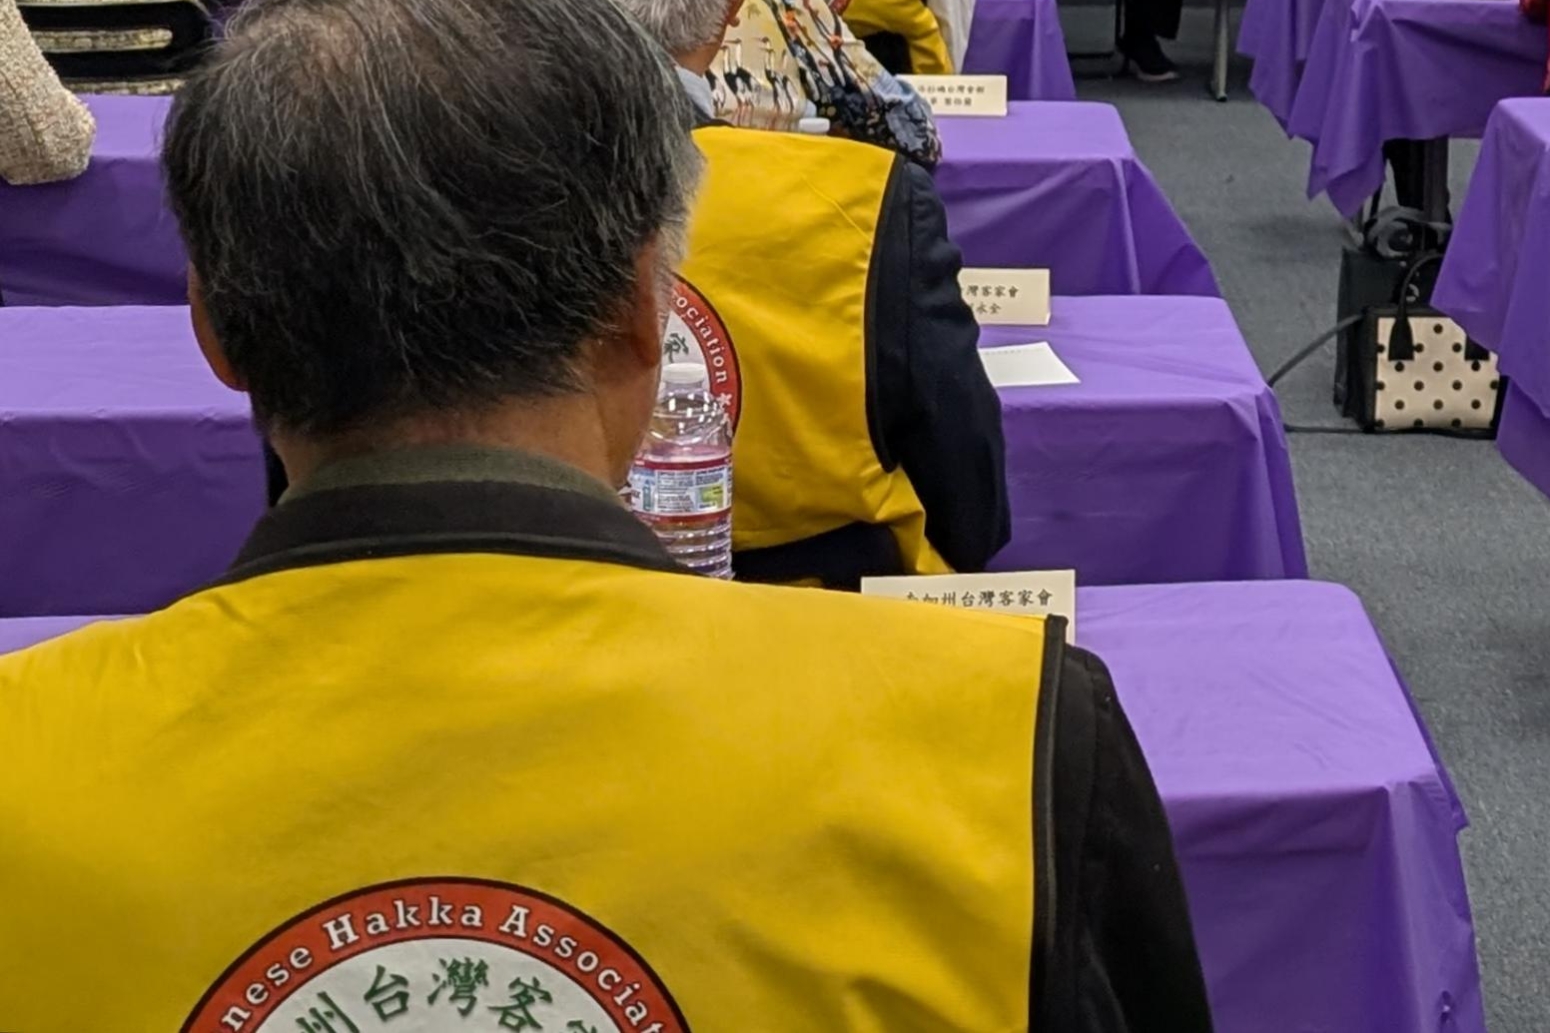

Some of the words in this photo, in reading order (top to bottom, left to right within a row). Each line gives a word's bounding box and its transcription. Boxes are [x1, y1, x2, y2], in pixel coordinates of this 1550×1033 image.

[963, 285, 1019, 298] 灣客家會
[674, 293, 728, 384] ociation
[221, 945, 313, 1032] nese
[322, 896, 483, 952] Hakka
[295, 956, 599, 1033] 州台灣客
